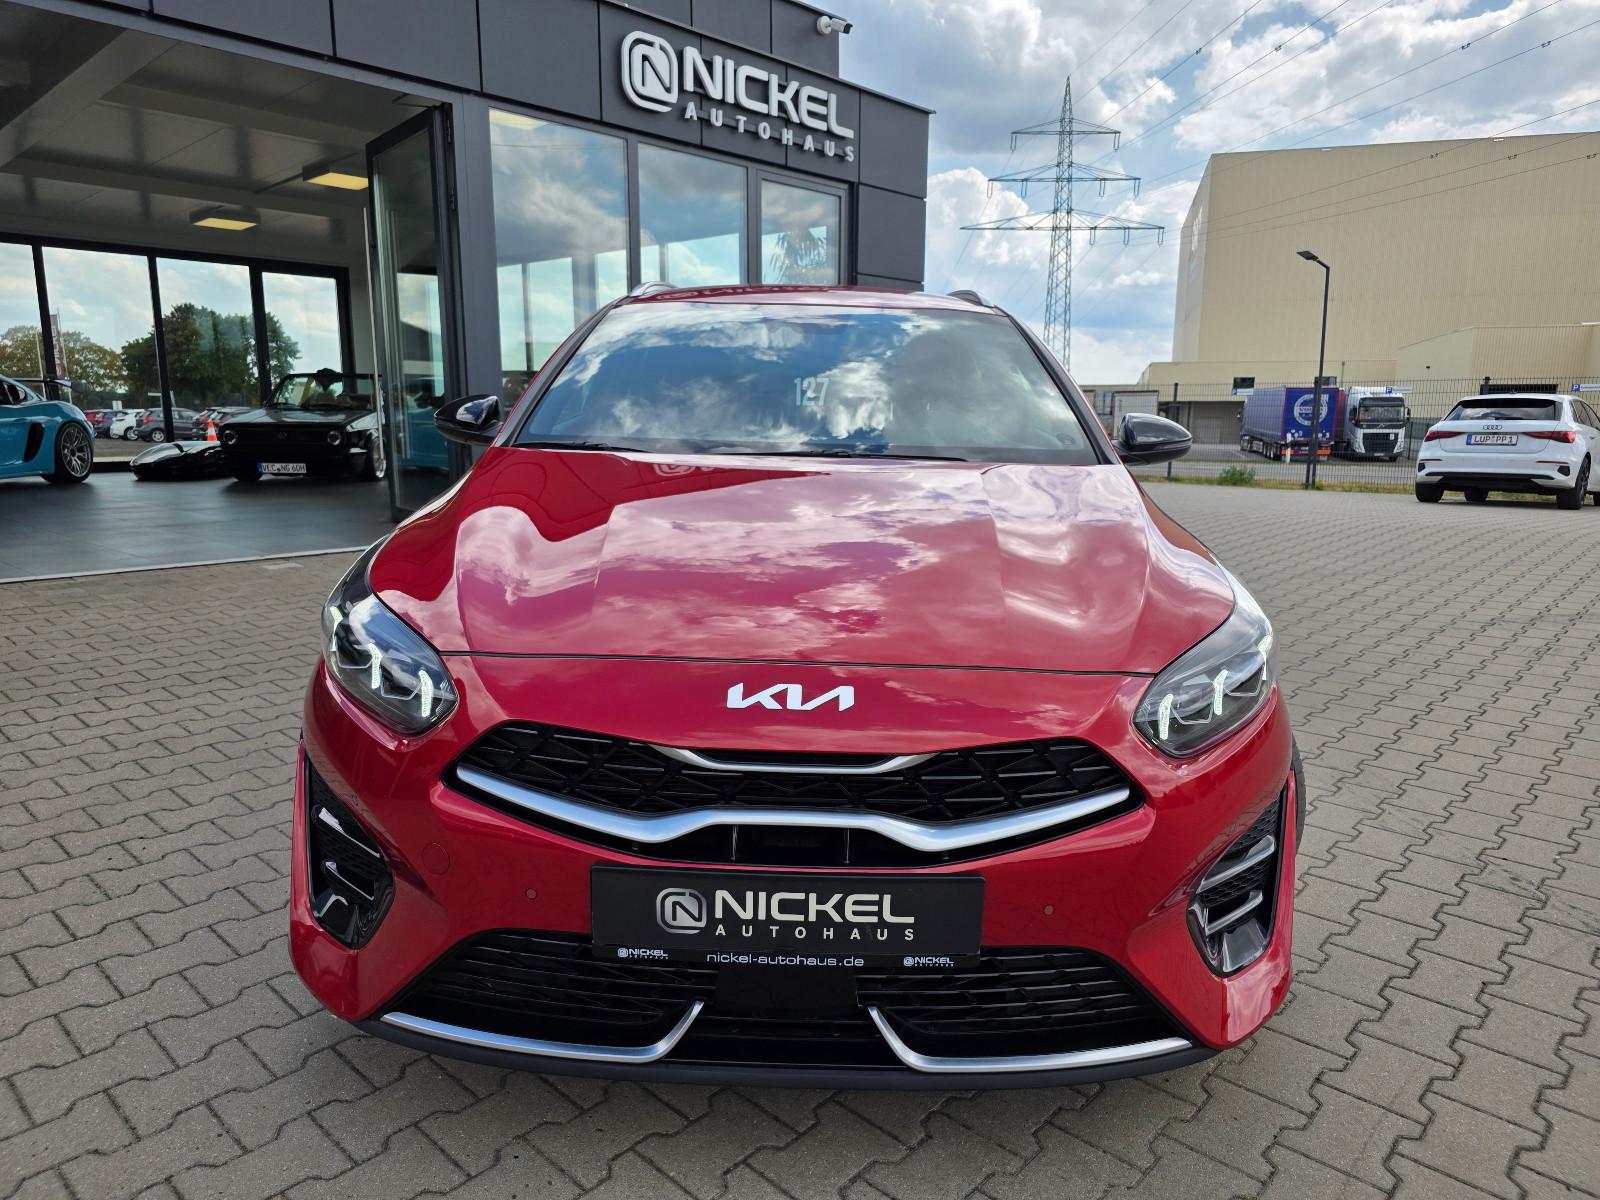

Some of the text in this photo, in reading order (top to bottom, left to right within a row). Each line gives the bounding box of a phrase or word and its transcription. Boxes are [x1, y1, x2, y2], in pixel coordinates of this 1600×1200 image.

[683, 46, 855, 139] NICKEL
[684, 101, 855, 163] AUTOHAUS
[794, 376, 830, 406] 127
[1474, 435, 1491, 443] LUP
[726, 682, 855, 712] KIA
[714, 889, 915, 924] NICKEL
[715, 924, 915, 941] AUTOHAUS
[629, 948, 669, 956] NICKEL
[706, 952, 865, 967] nickel-autohaus.de
[914, 956, 955, 964] NICKEL
